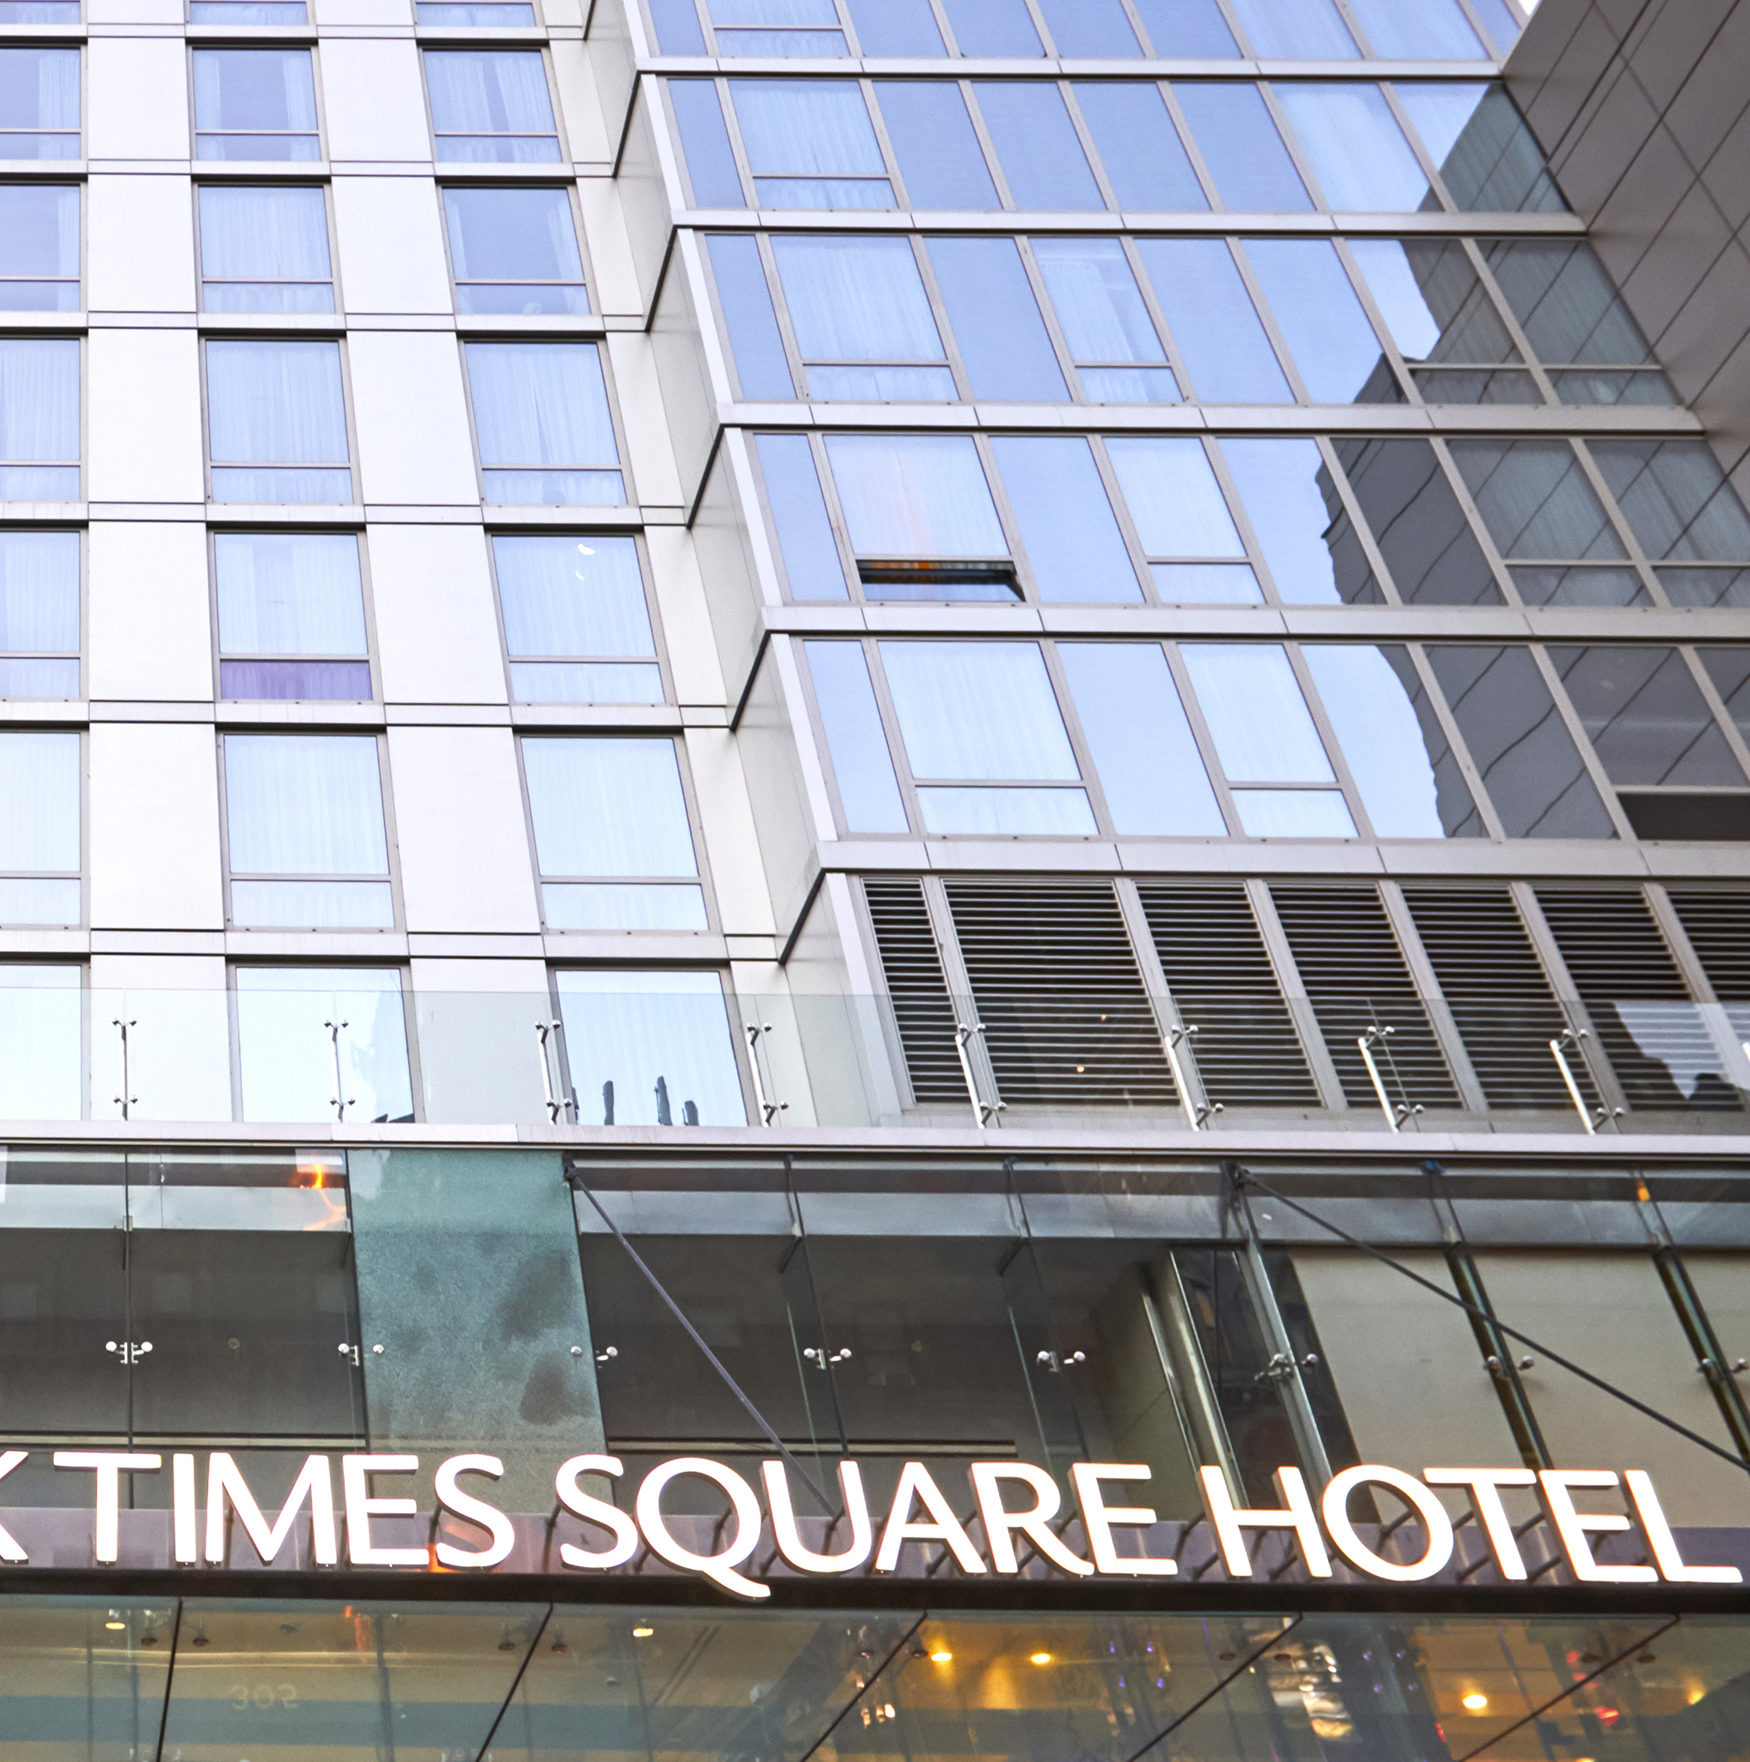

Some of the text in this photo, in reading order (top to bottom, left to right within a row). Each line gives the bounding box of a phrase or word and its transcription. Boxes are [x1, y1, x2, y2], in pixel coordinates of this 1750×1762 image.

[53, 1450, 517, 1570] TIMES
[555, 1454, 1179, 1599] SQUARE
[1199, 1464, 1743, 1583] HOTEL
